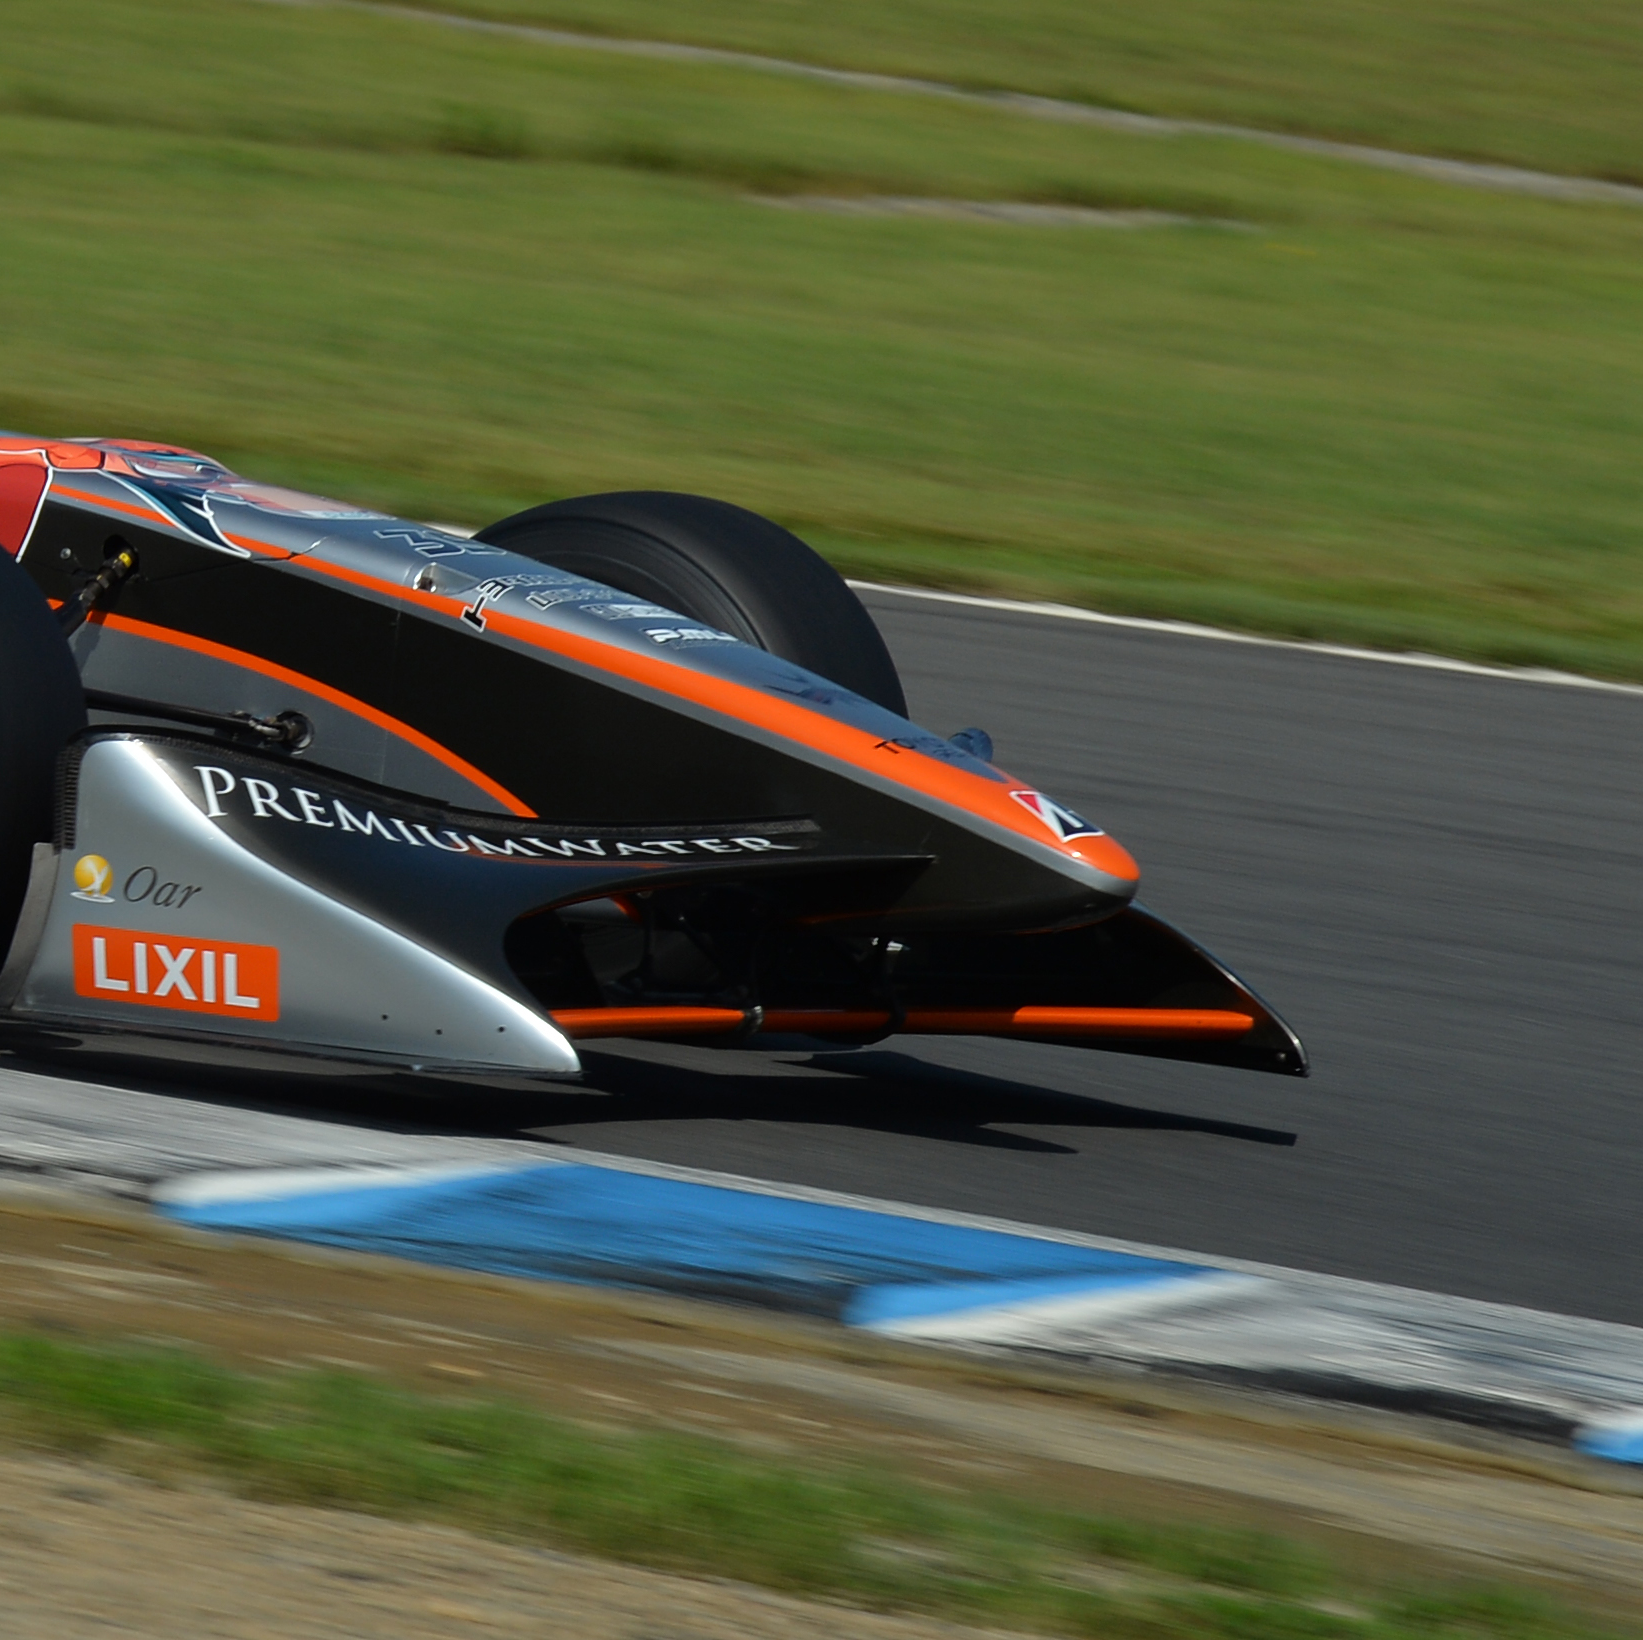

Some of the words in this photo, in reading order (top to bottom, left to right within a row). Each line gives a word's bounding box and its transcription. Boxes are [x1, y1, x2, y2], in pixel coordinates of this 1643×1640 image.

[193, 764, 801, 859] PREMIUMWATER
[123, 865, 203, 909] Oar
[92, 936, 261, 1009] LIXIL
